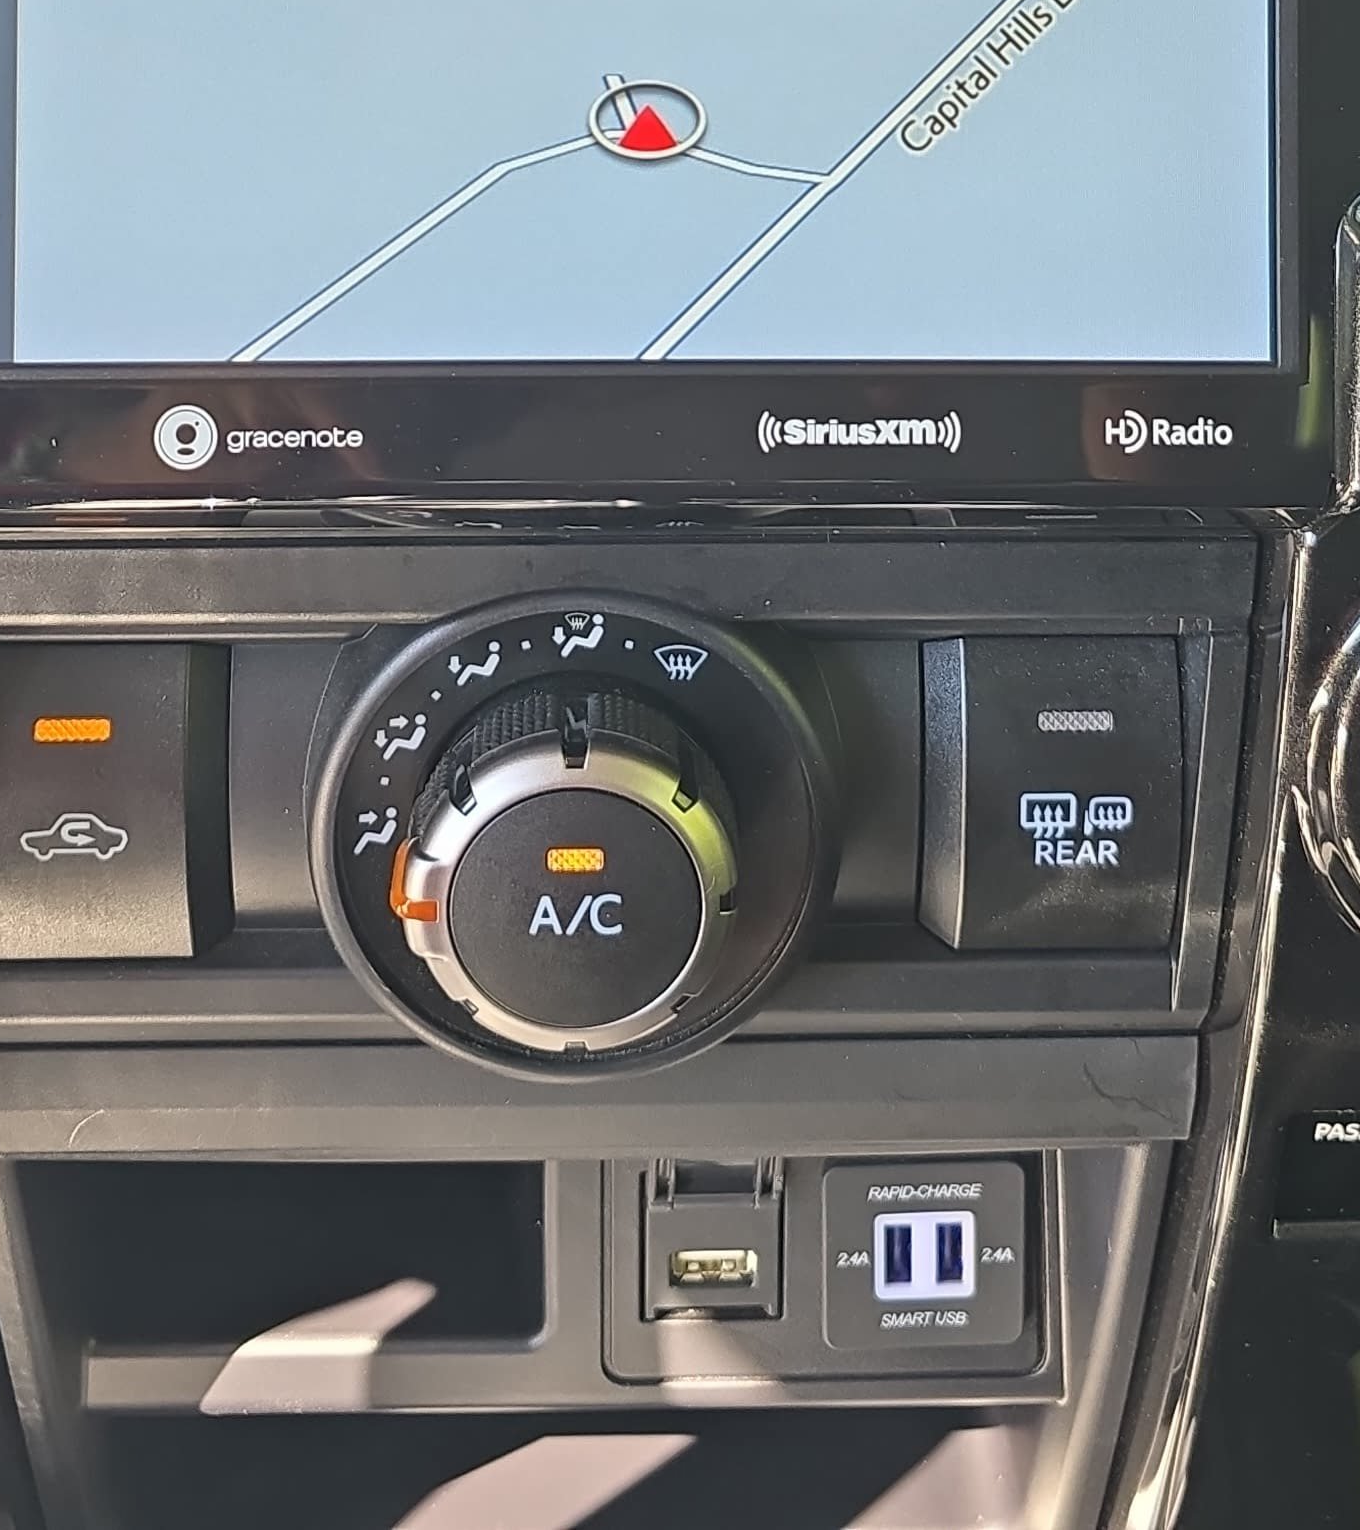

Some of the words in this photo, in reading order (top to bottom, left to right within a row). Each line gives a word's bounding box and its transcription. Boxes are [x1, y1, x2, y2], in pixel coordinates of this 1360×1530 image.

[901, 55, 999, 152] Capital
[986, 5, 1054, 66] Hills
[226, 427, 364, 454] gracenote
[783, 419, 937, 445] SiriusXM
[1105, 411, 1146, 451] HD
[1152, 417, 1233, 446] Radio
[1033, 840, 1120, 867] REAR
[529, 894, 624, 937] A/C
[867, 1183, 983, 1201] RAPID-CHARGE
[837, 1250, 871, 1267] 2.4A
[981, 1246, 1016, 1263] 2.4A
[881, 1311, 932, 1327] SMART
[936, 1310, 967, 1326] USB
